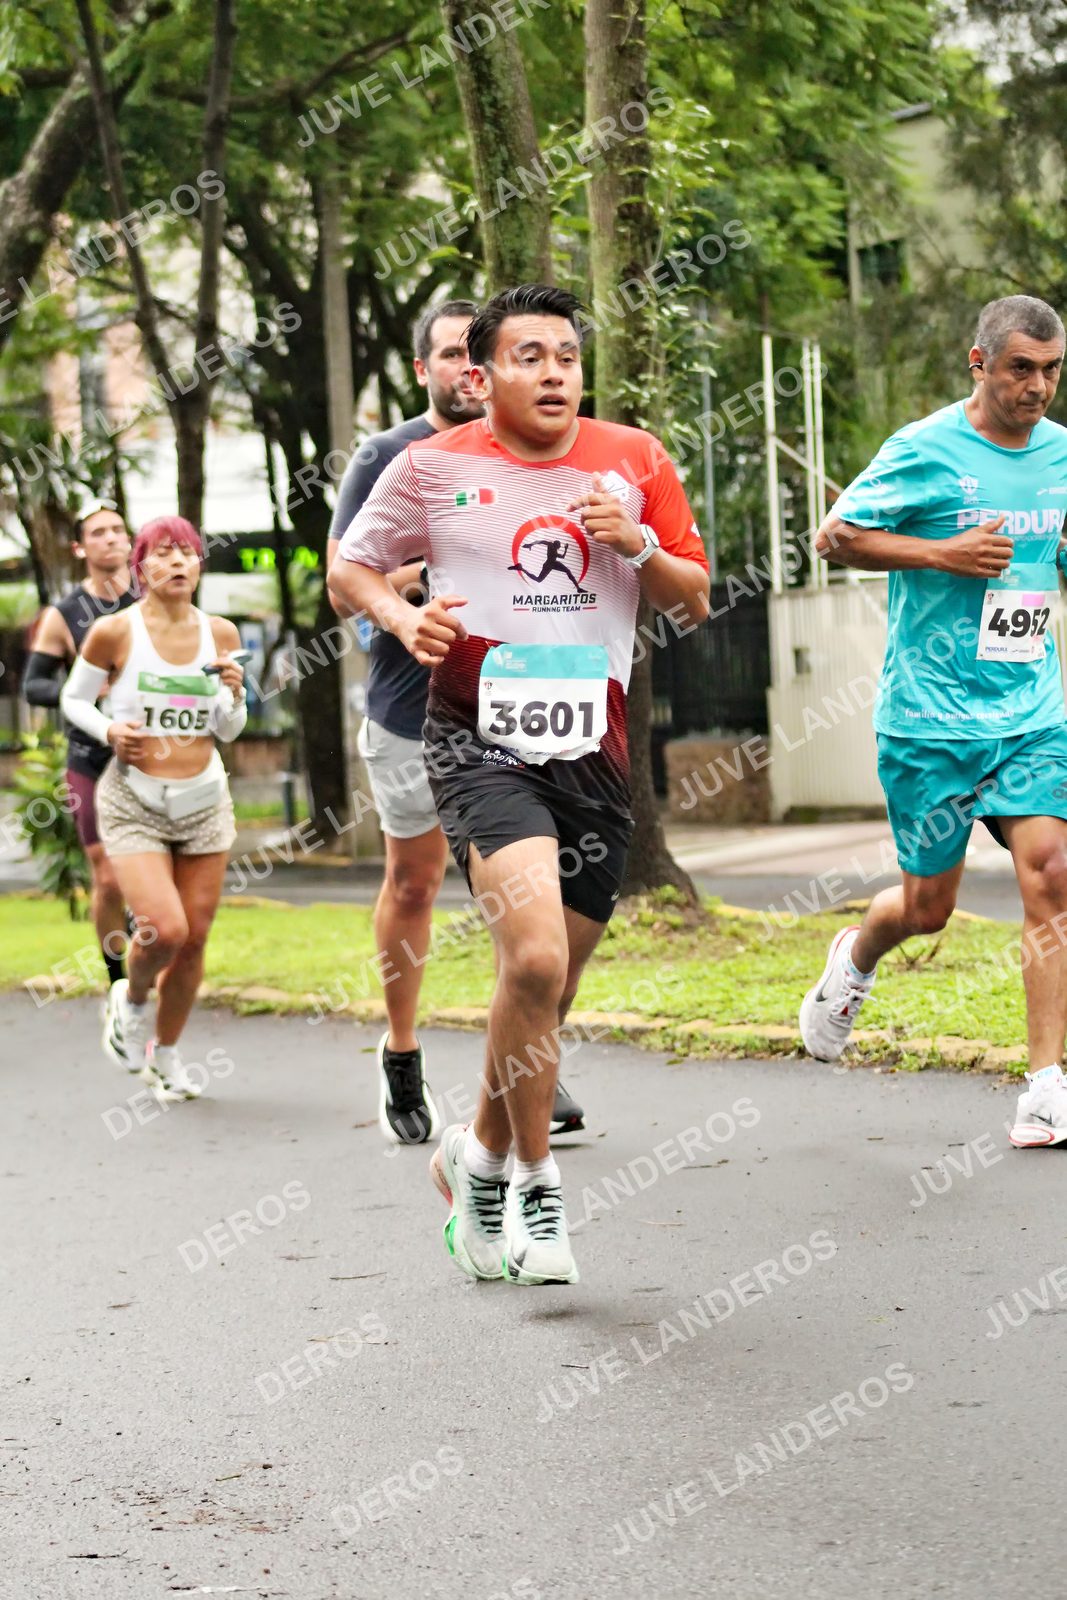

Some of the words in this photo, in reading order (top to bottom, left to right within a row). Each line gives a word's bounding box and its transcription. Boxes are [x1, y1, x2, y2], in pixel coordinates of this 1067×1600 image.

[512, 593, 597, 606] MARGARITOS
[988, 607, 1051, 638] 4952
[143, 706, 210, 731] 1605
[488, 700, 594, 738] 3601
